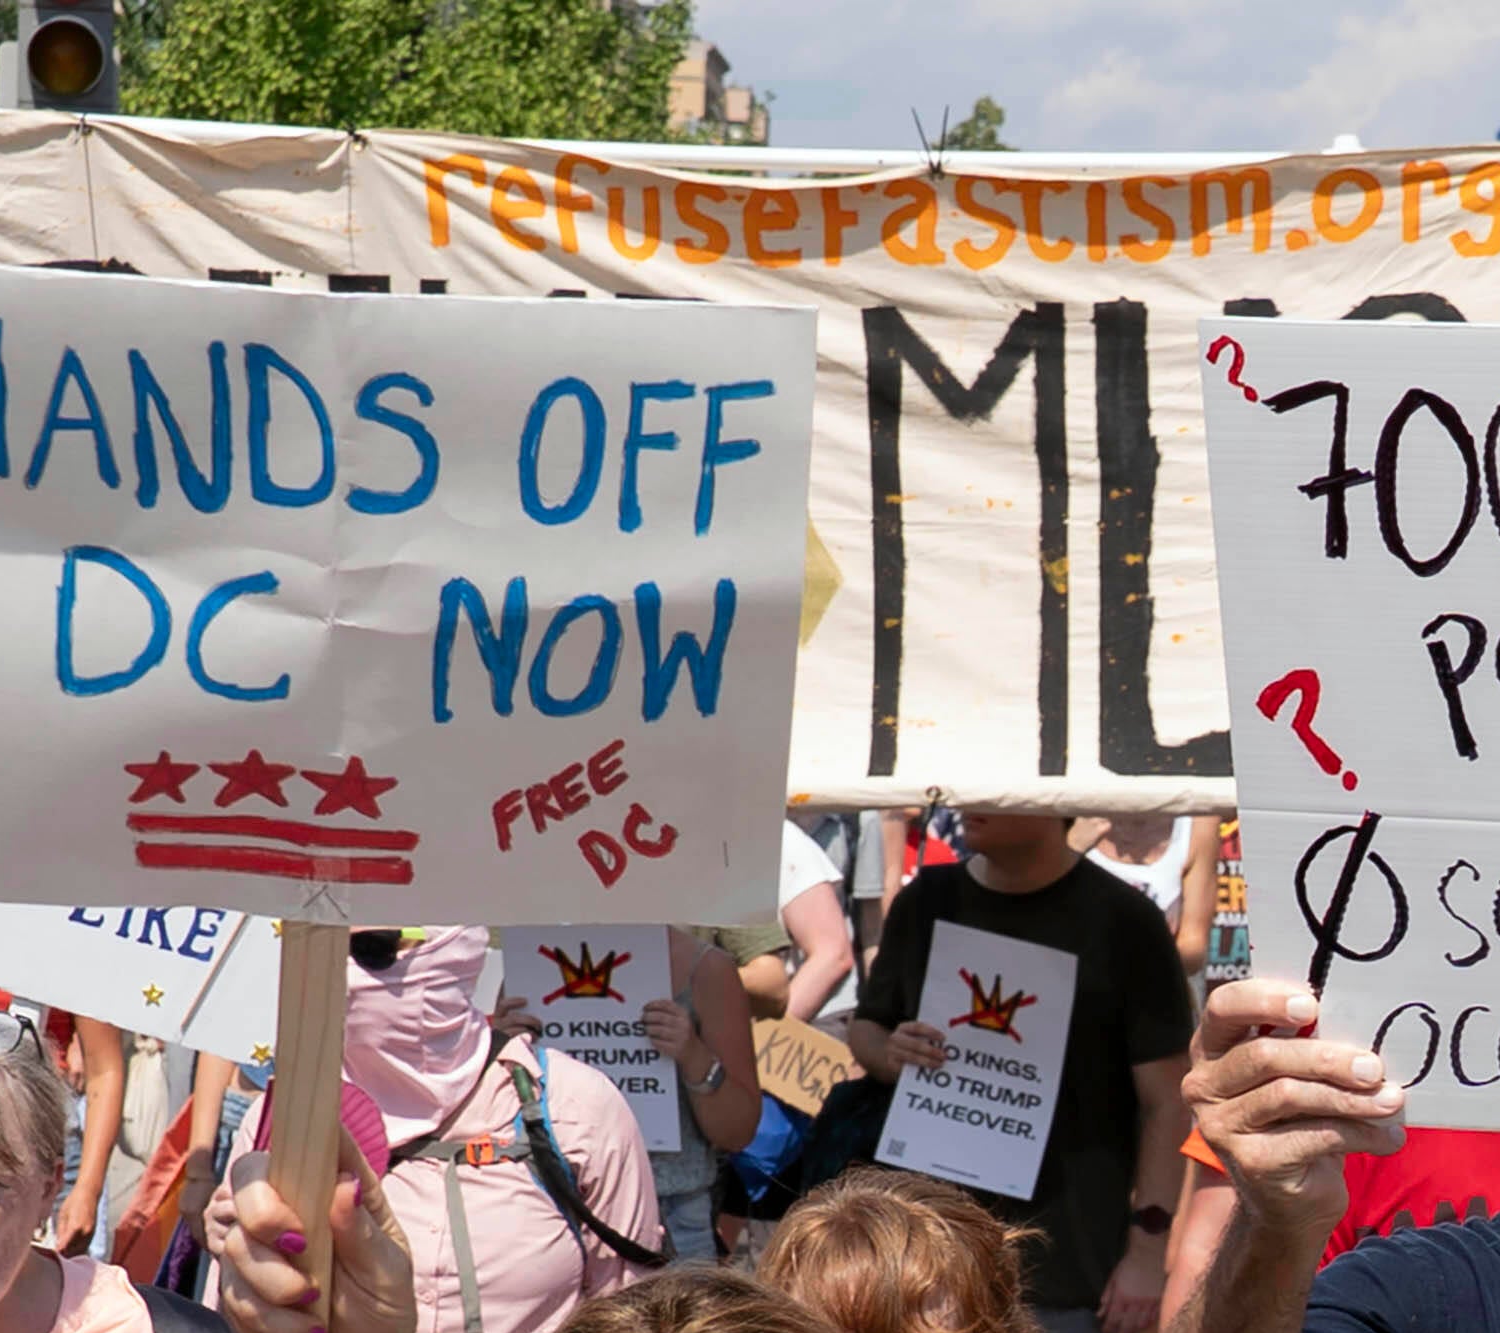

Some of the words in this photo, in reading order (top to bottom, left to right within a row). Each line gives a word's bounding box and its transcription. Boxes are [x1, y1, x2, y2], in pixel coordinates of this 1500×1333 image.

[517, 377, 775, 538] OFF
[55, 545, 291, 701] DC
[433, 576, 736, 723] NOW
[1257, 669, 1359, 791] ?
[492, 738, 629, 852] FREE
[578, 803, 678, 889] DC
[917, 1065, 950, 1089] NO
[957, 1074, 1042, 1111] TRUMP
[964, 1044, 1041, 1082] KINGS.
[906, 1092, 1037, 1141] TAKEOVER.
